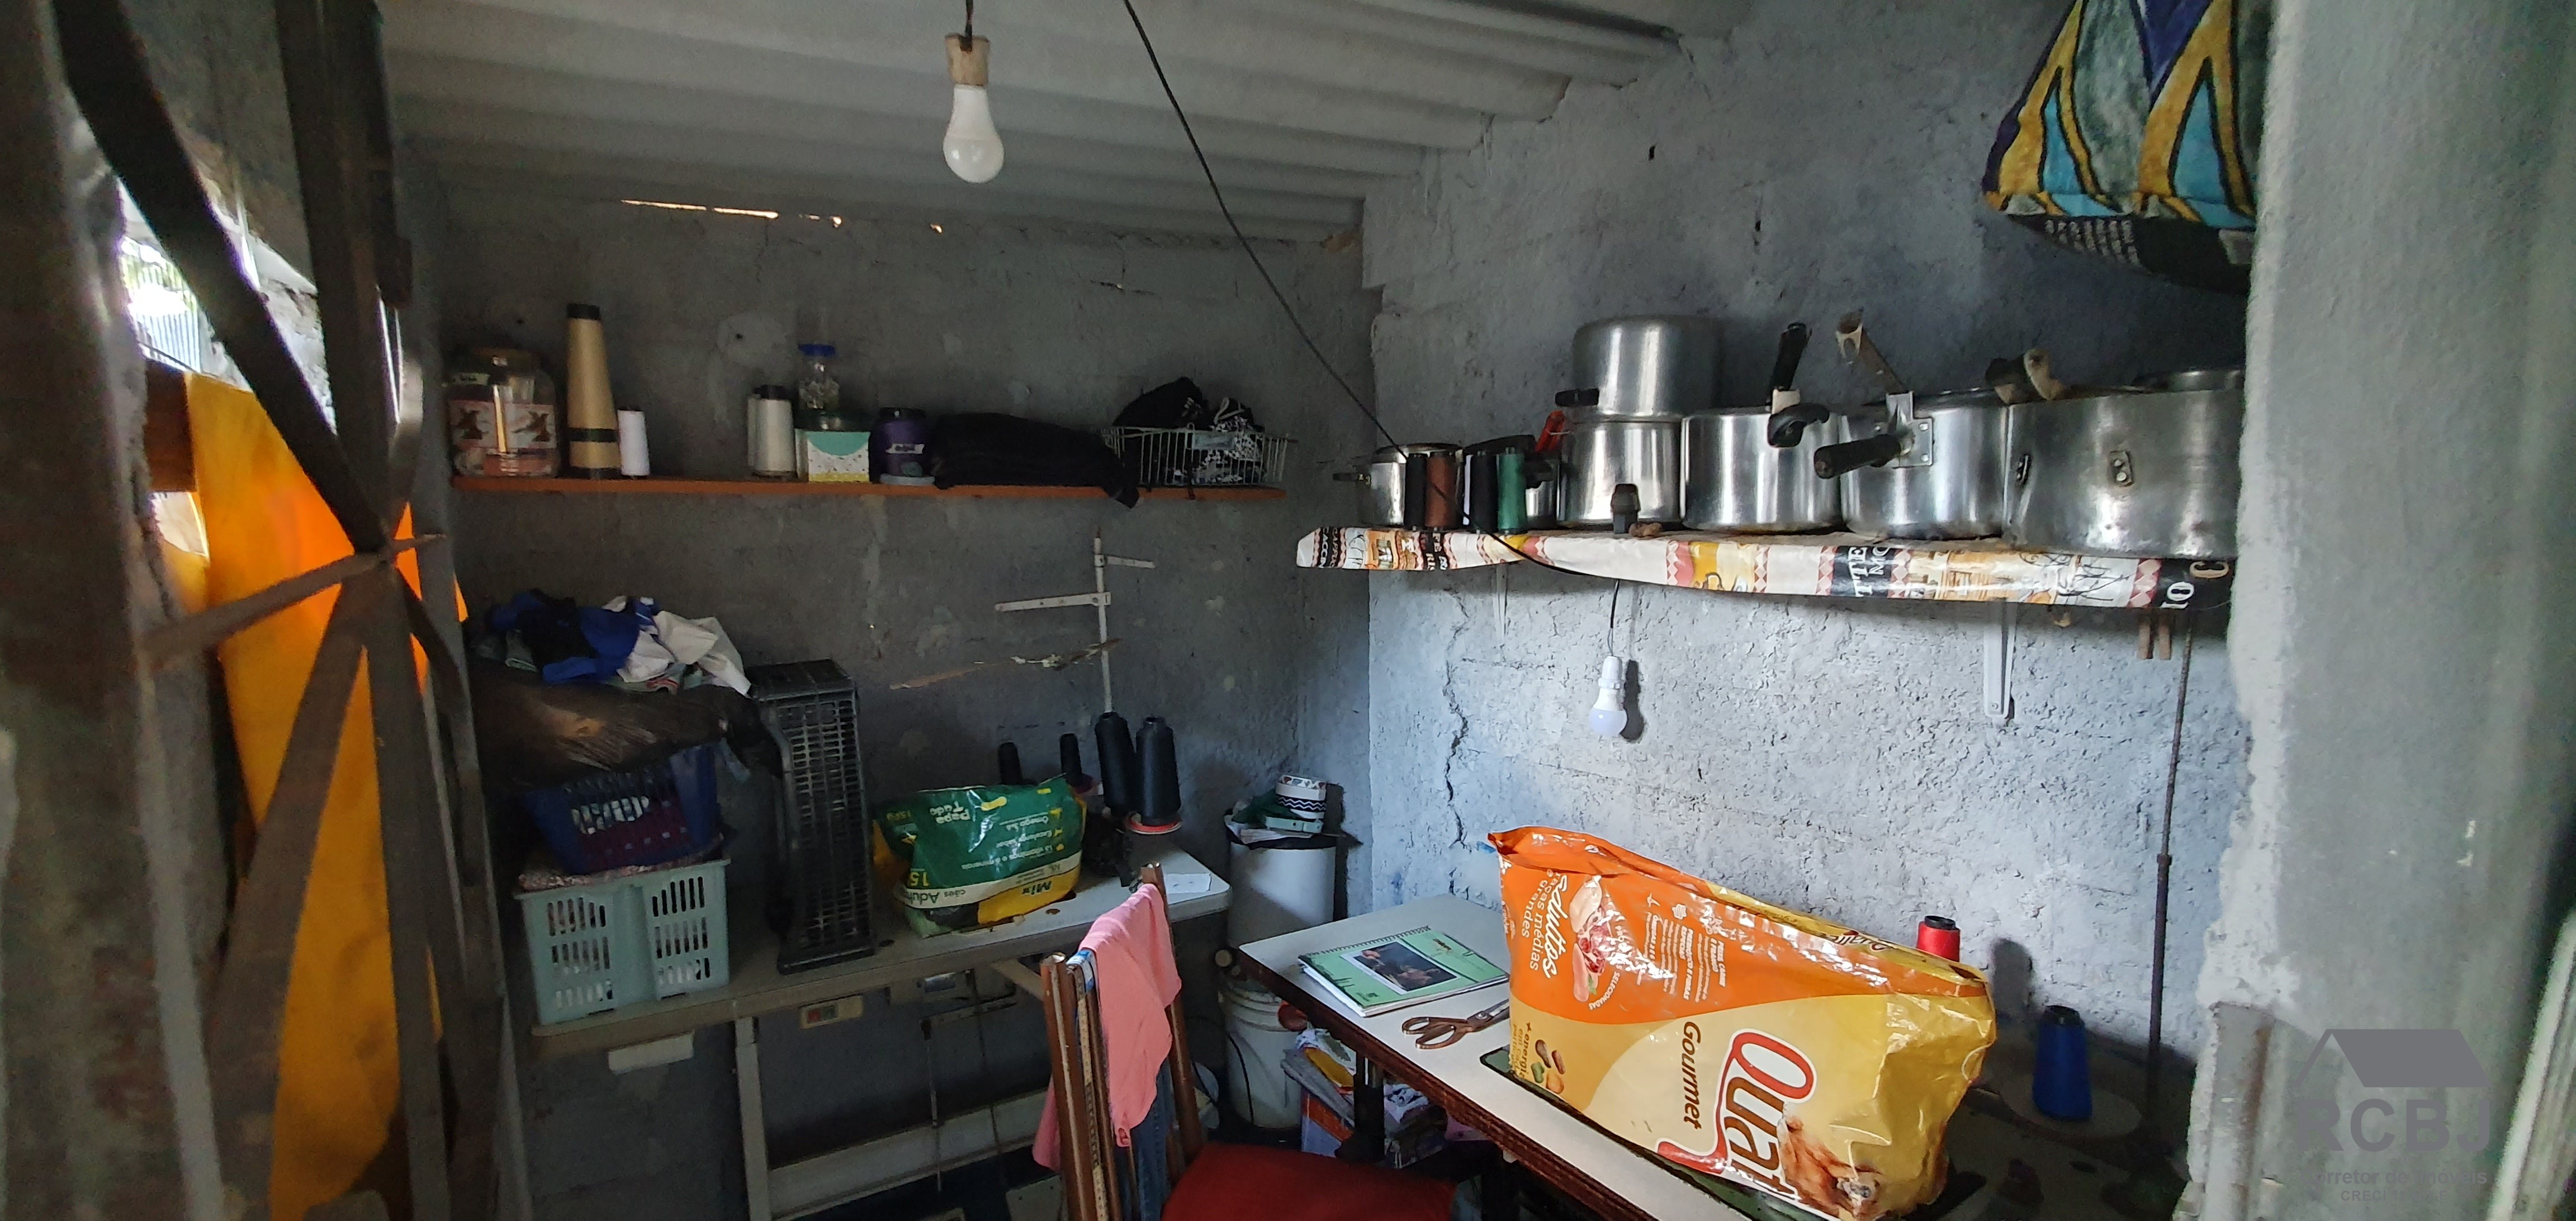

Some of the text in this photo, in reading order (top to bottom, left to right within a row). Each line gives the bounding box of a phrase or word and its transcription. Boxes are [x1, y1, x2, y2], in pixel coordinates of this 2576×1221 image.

[944, 888, 966, 899] cães
[1022, 881, 1052, 896] Mix
[1521, 880, 1548, 938] grandes
[1529, 912, 1545, 971] médias
[1682, 1021, 1702, 1130] Gourmet
